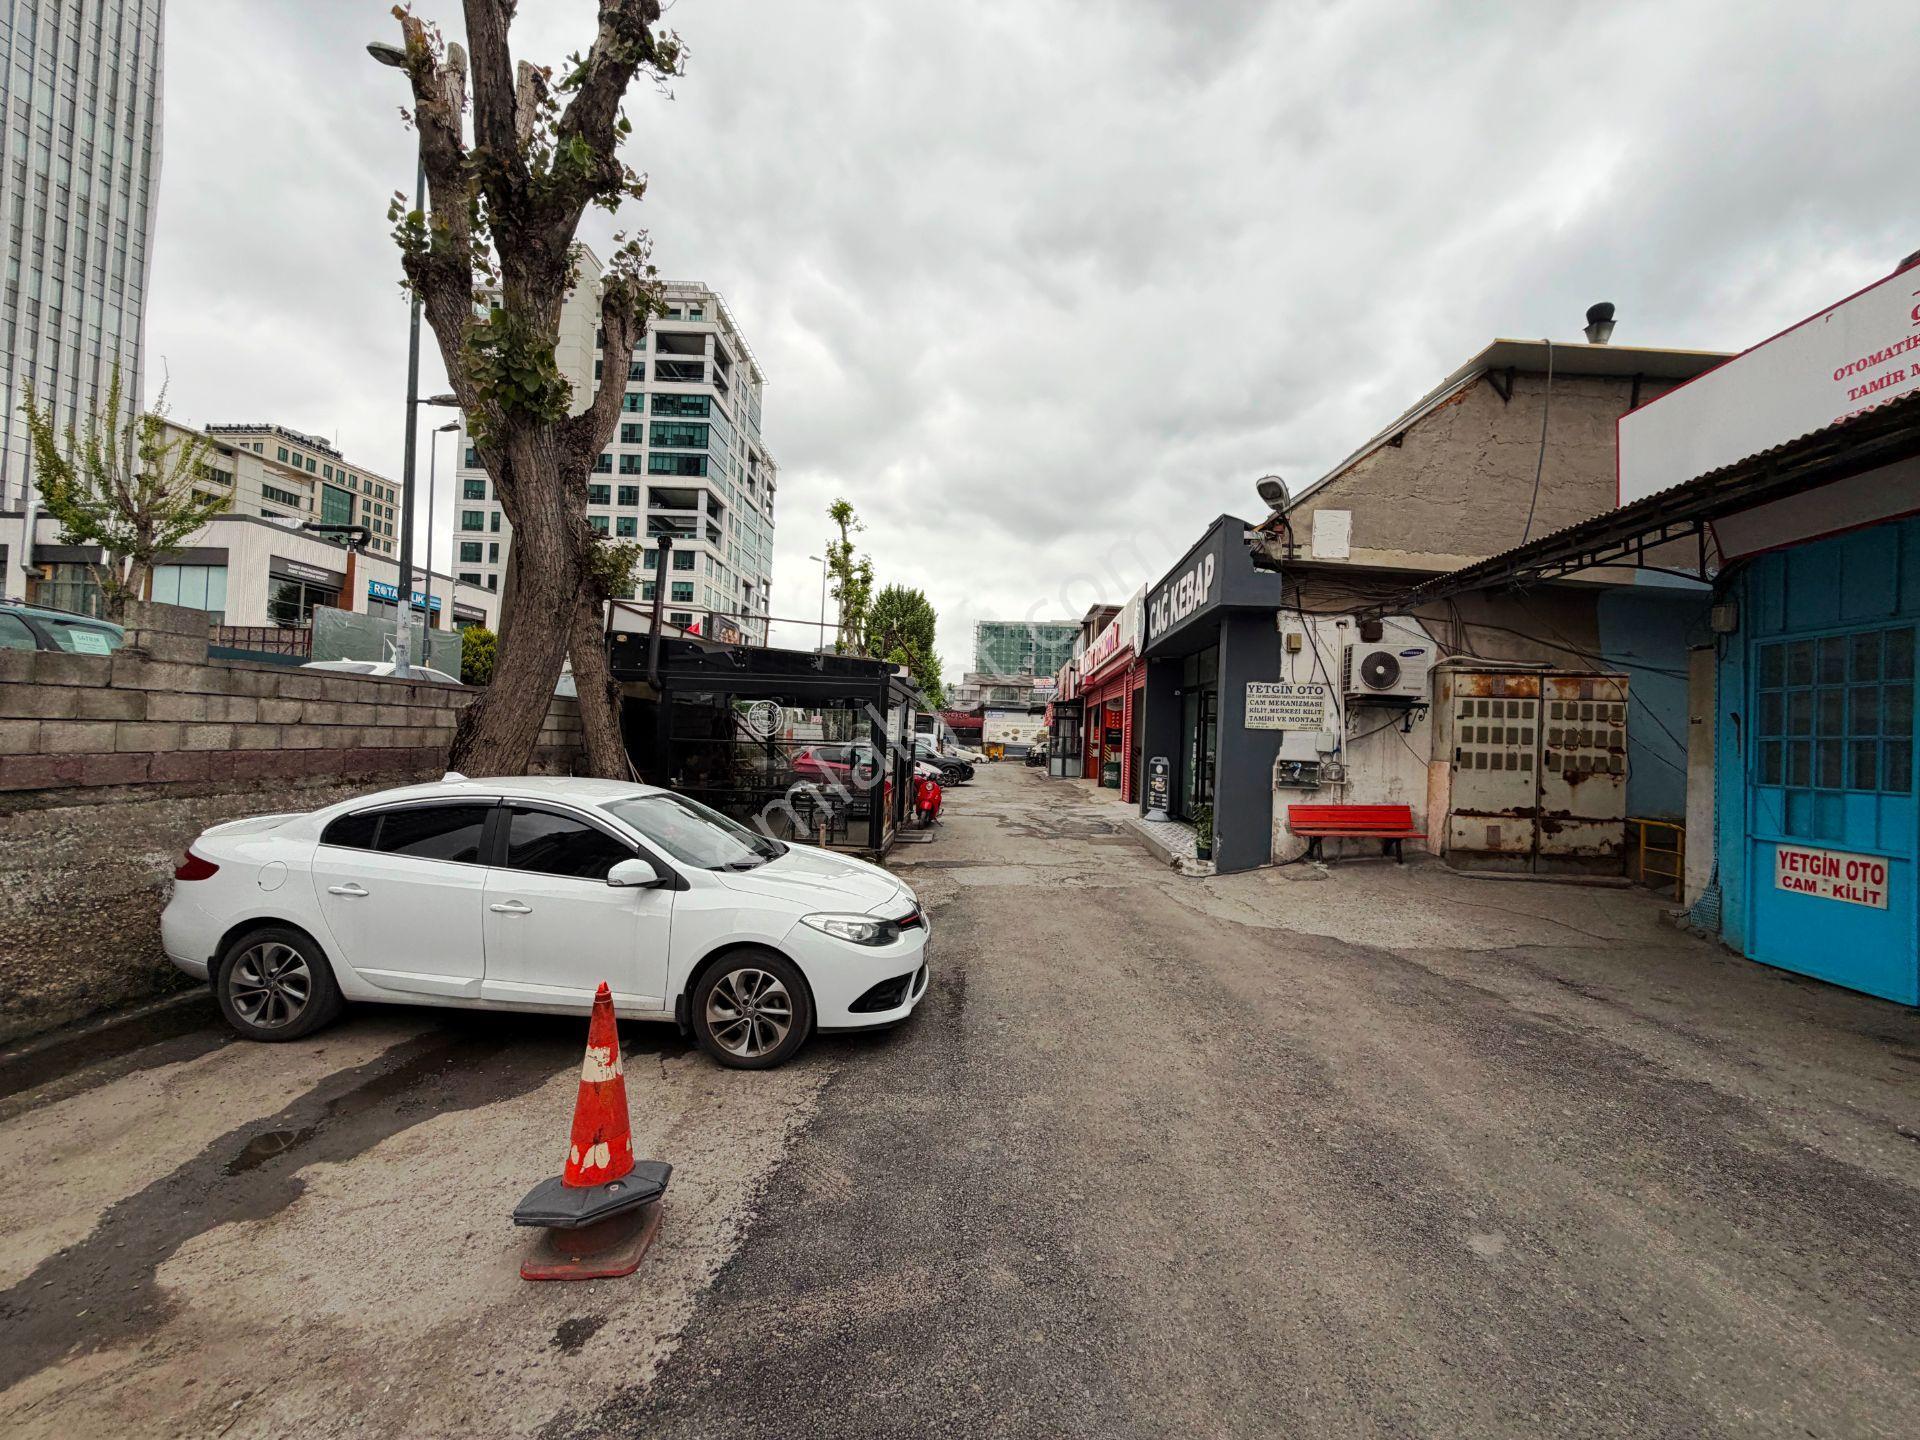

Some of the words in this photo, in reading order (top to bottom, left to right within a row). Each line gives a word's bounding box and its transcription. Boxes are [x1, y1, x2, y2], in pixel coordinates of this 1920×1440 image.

[1847, 369, 1906, 401] TAMİR
[1169, 553, 1215, 626] KEBAP
[1297, 686, 1323, 694] OTO
[1779, 850, 1840, 878] YETGİN
[1846, 860, 1884, 885] OTO
[1782, 876, 1817, 893] CAM
[1833, 883, 1881, 905] KİLİT
